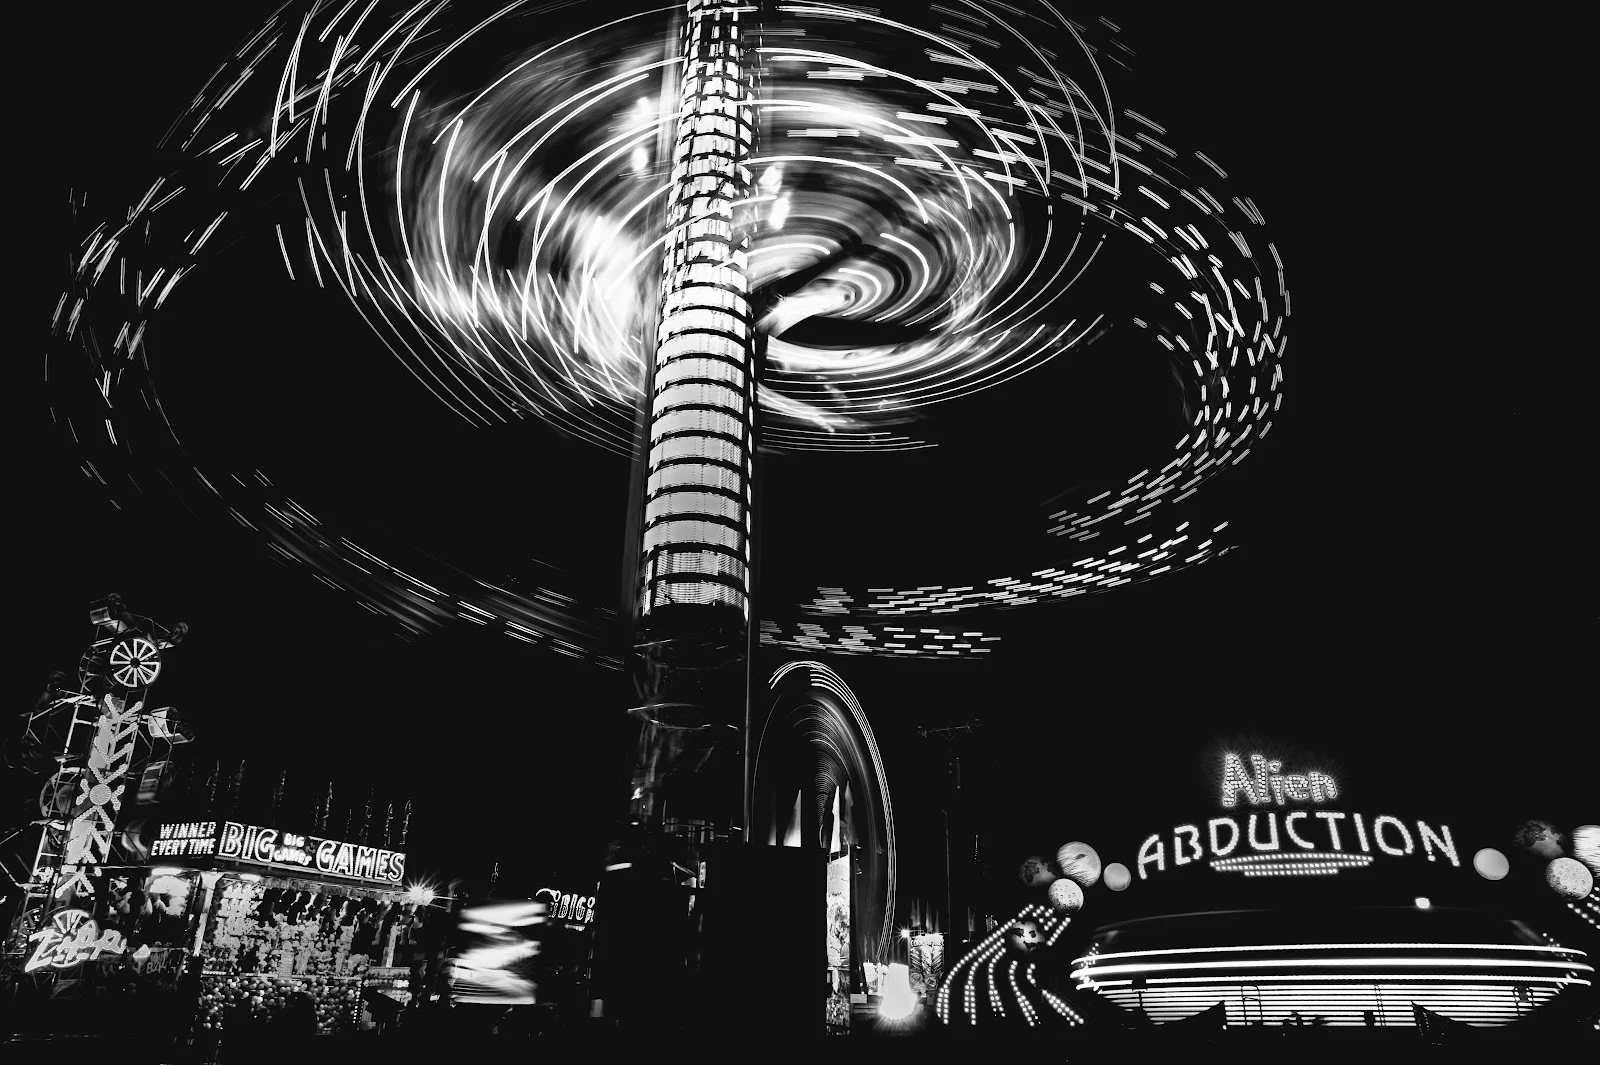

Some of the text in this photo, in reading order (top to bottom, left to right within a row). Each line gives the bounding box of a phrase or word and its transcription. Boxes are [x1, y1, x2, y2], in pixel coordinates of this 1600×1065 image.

[1222, 754, 1338, 806] Alien
[160, 821, 217, 839] WINNER
[283, 832, 305, 847] BIG
[150, 838, 216, 856] EVERY TIME
[218, 821, 405, 882] BIG GAMES
[1138, 810, 1460, 879] ABDUCTION
[273, 847, 313, 866] GAMES
